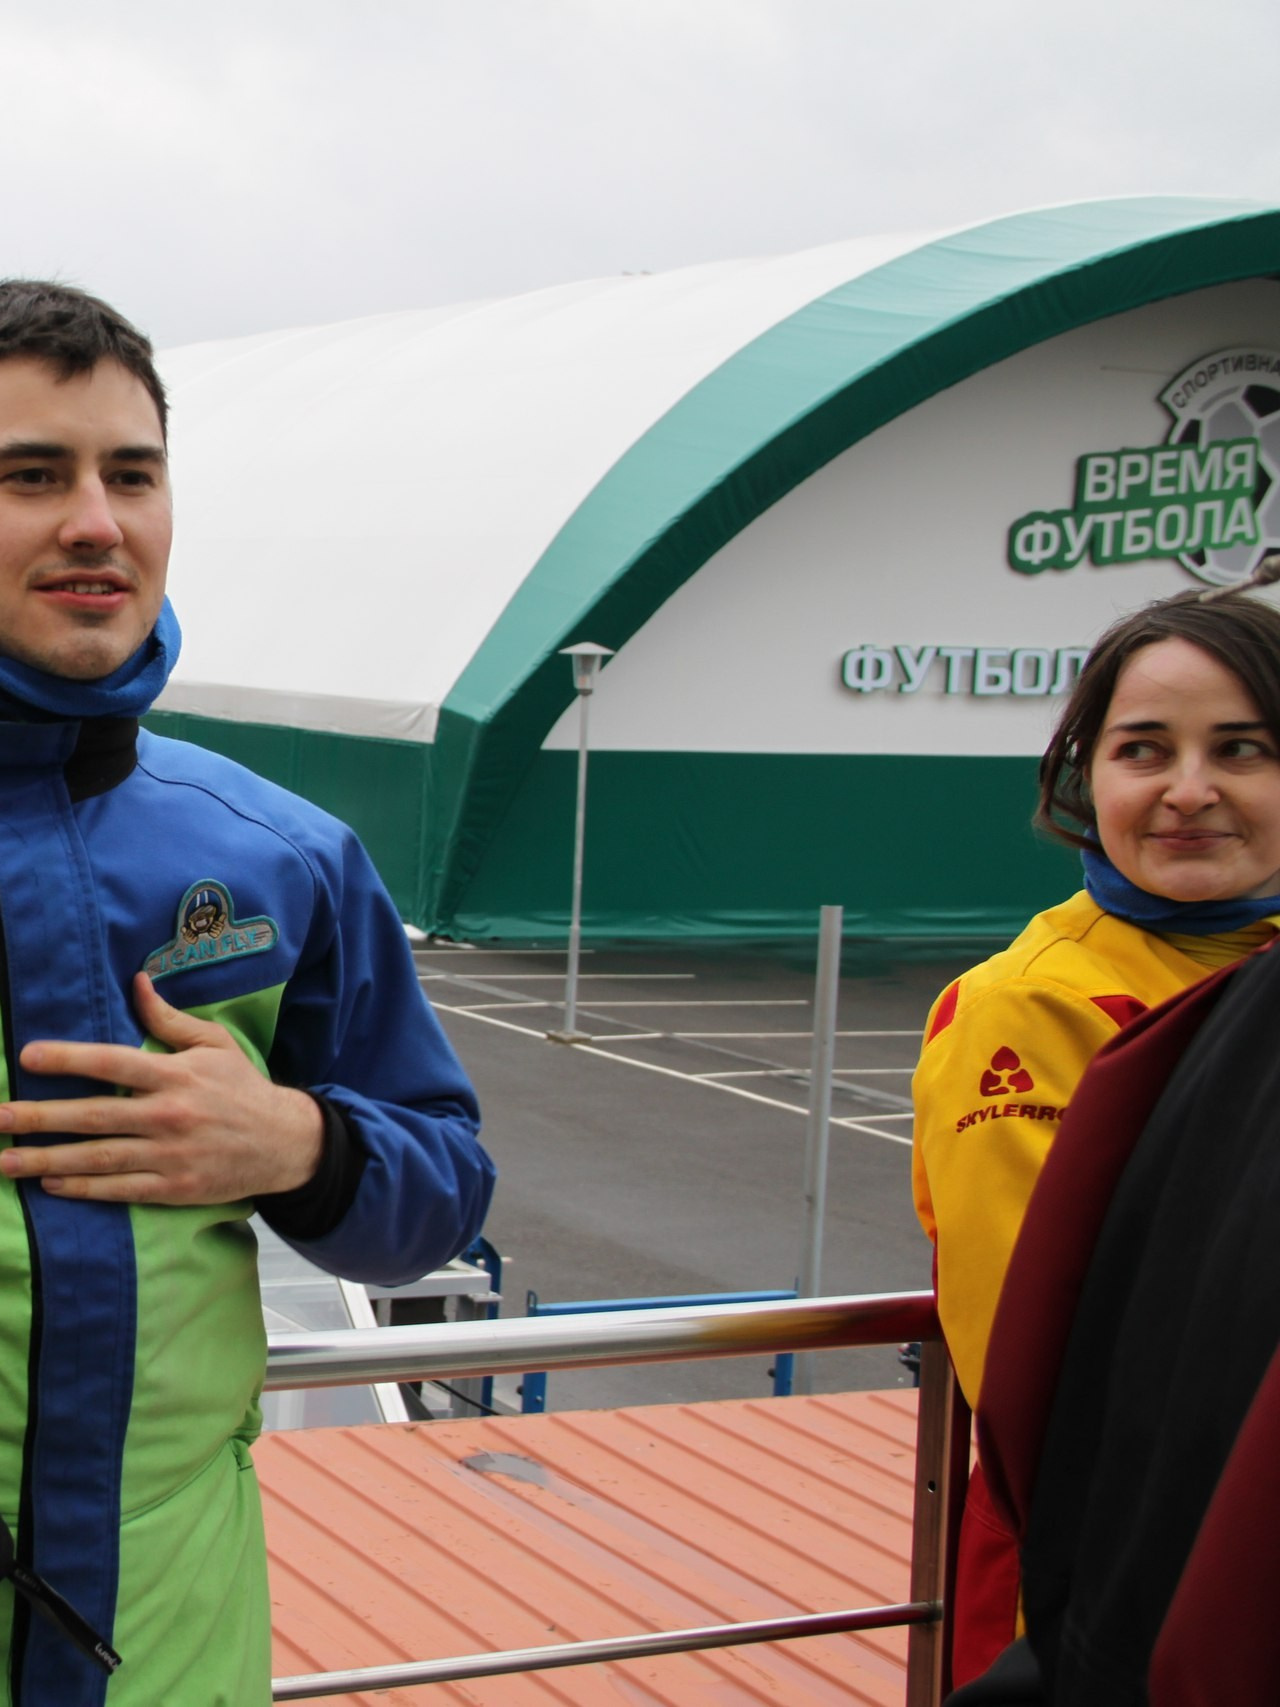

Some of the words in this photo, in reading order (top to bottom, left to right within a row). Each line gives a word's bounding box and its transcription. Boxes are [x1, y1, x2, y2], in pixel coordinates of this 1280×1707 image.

[1083, 443, 1256, 502] ВРЕМЯ
[1014, 496, 1257, 566] ФУТБОЛА
[842, 644, 1091, 696] ФУТБОЛ
[160, 955, 167, 971] I
[170, 939, 217, 966] CAN
[221, 928, 257, 952] FLY
